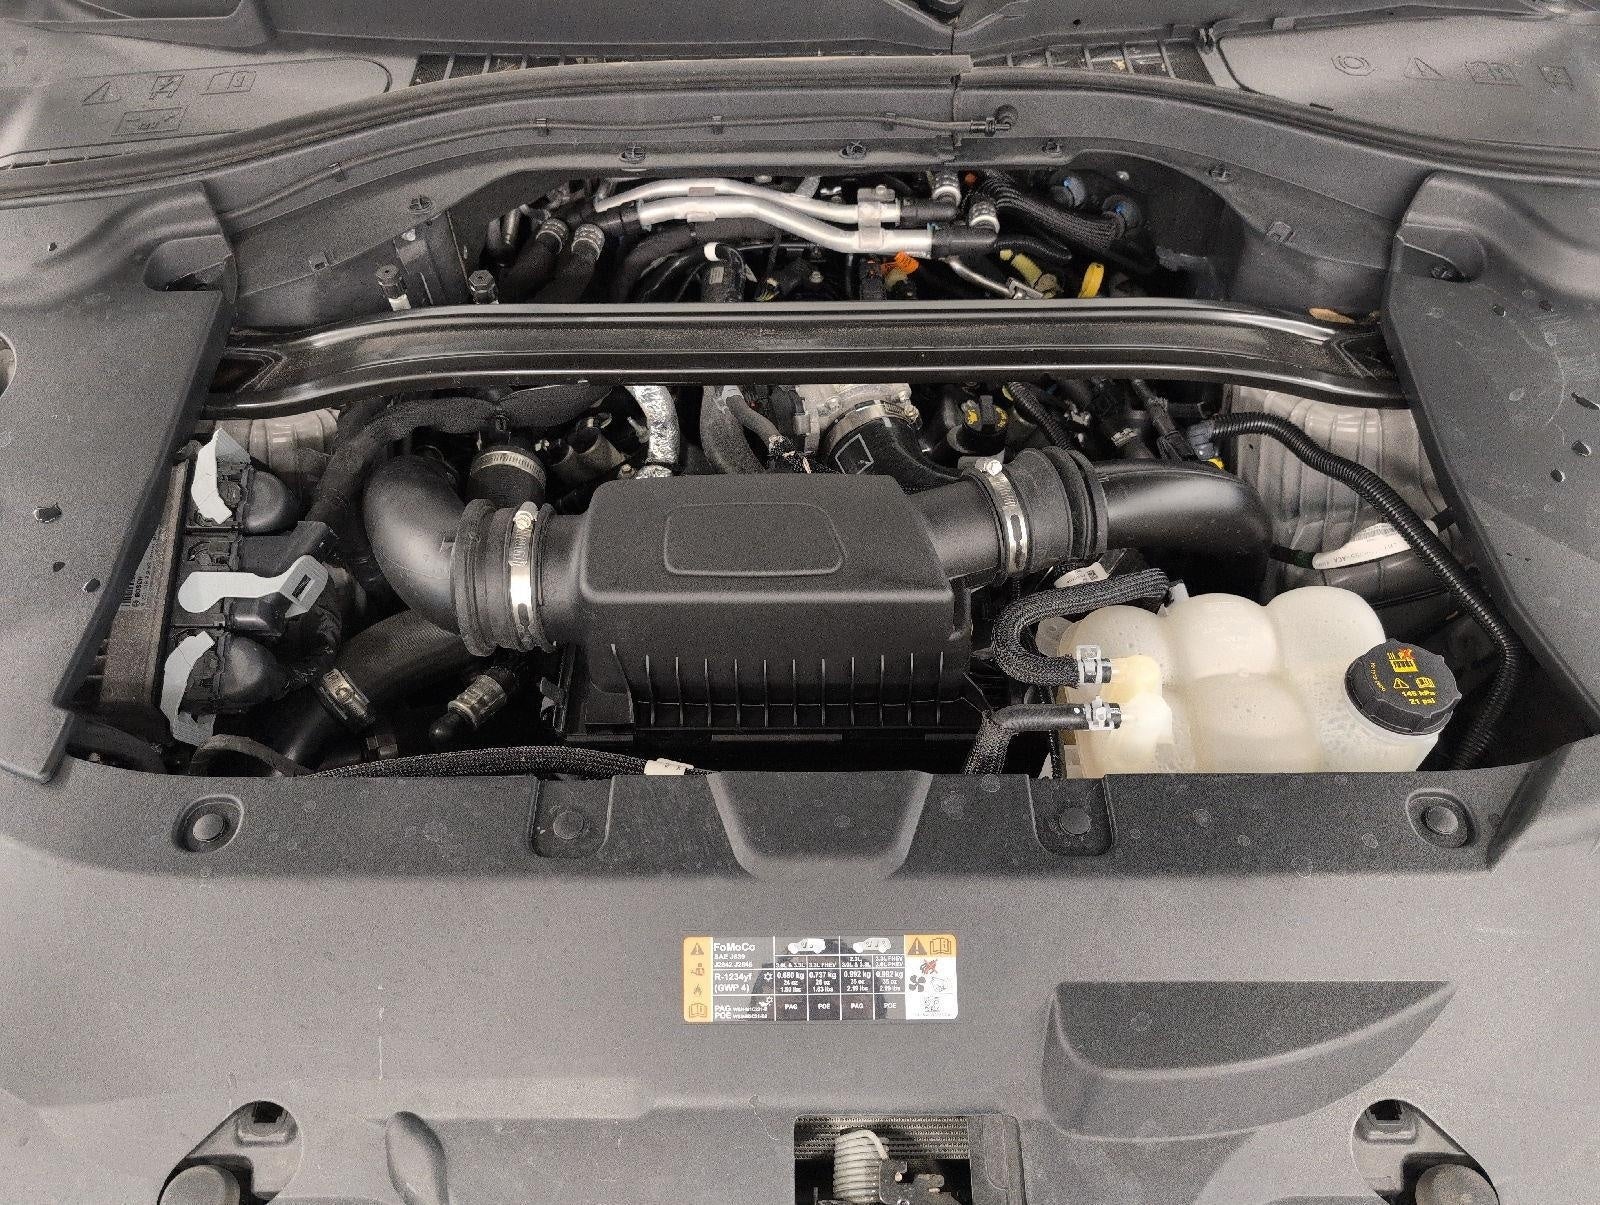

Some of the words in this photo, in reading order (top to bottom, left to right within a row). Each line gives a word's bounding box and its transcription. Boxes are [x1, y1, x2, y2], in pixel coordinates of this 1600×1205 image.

[134, 577, 143, 598] BOSCH
[1422, 697, 1436, 706] psi
[713, 942, 756, 952] FoMoCo
[714, 972, 753, 982] R-1234yf
[795, 971, 805, 980] kg
[809, 971, 827, 979] 0.737
[827, 971, 837, 980] kg
[843, 970, 861, 978] 0.992
[862, 970, 872, 979] kg
[894, 970, 904, 979] kg
[714, 984, 740, 994] (GWP
[740, 983, 750, 994] 4)
[714, 1004, 732, 1012] PAG
[817, 1002, 831, 1010] POE
[714, 1012, 732, 1020] POE
